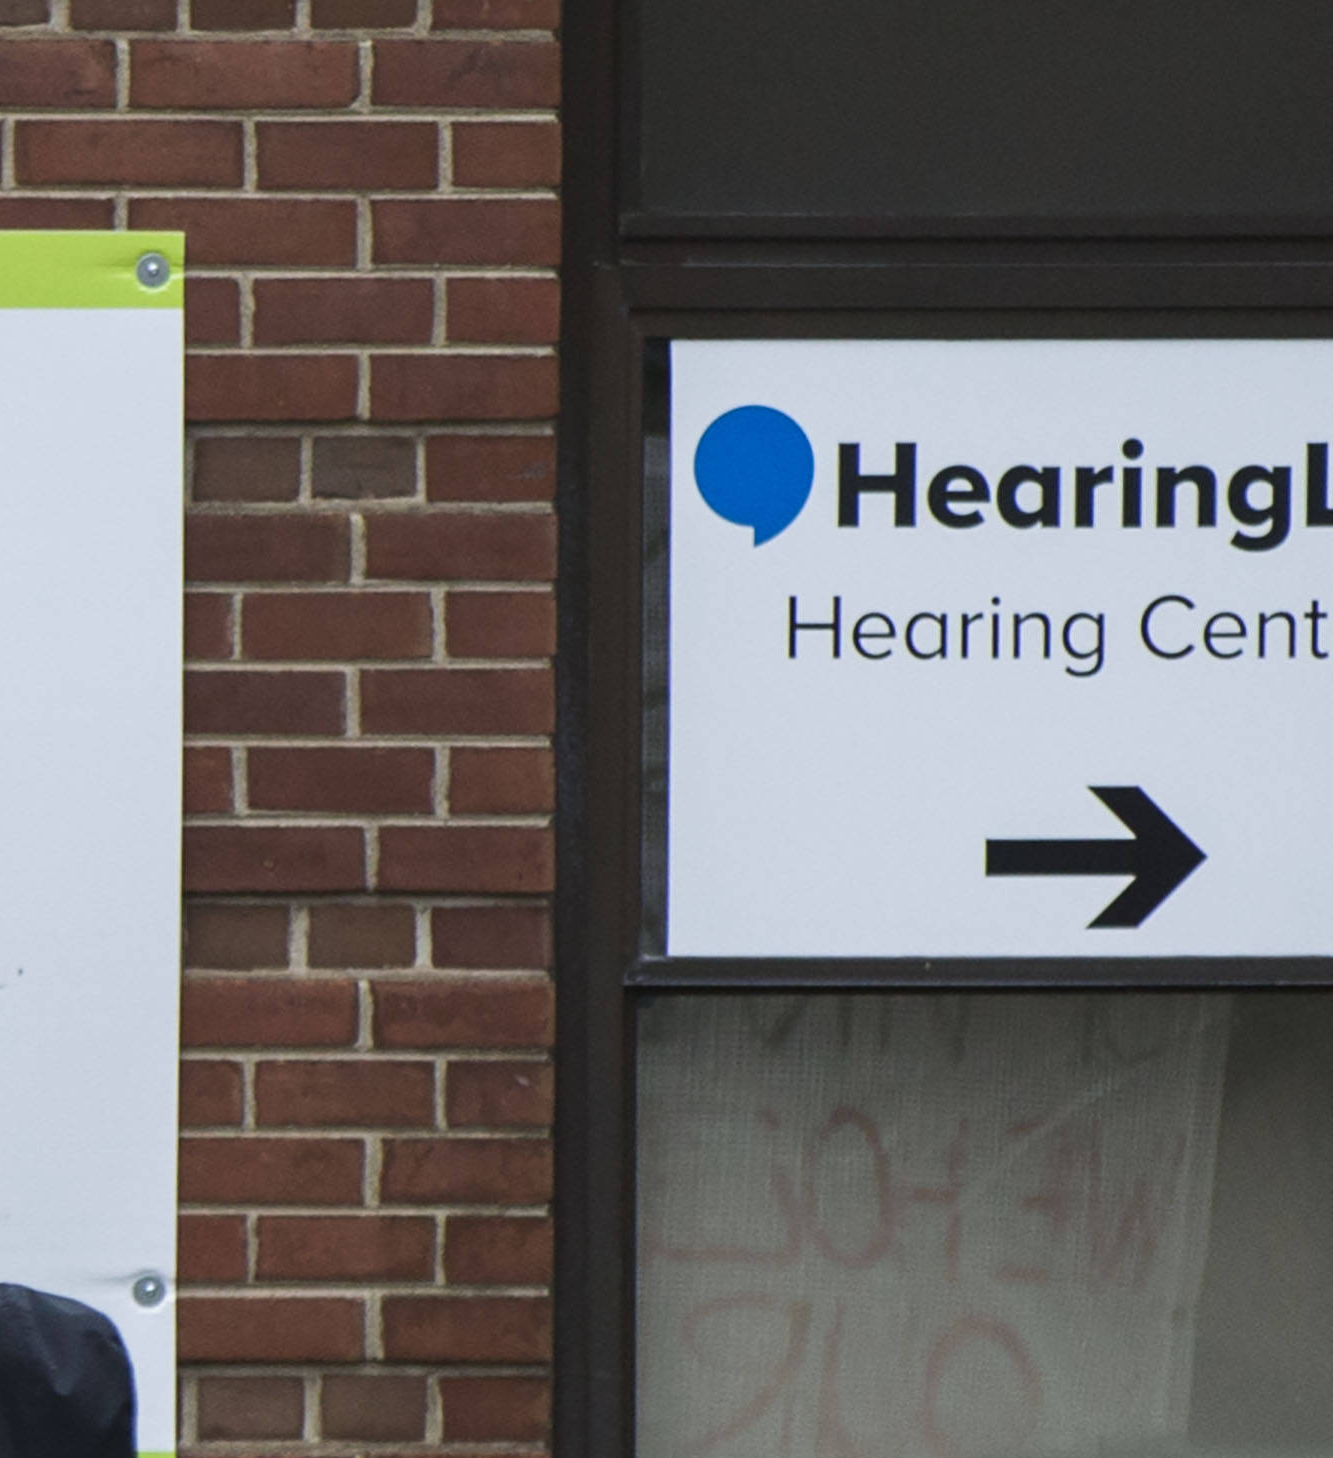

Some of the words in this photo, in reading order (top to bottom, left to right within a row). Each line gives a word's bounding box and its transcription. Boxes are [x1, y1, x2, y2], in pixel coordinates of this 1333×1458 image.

[838, 439, 1333, 552] HearingL
[788, 595, 1105, 678] Hearing
[1140, 594, 1330, 660] Cent
